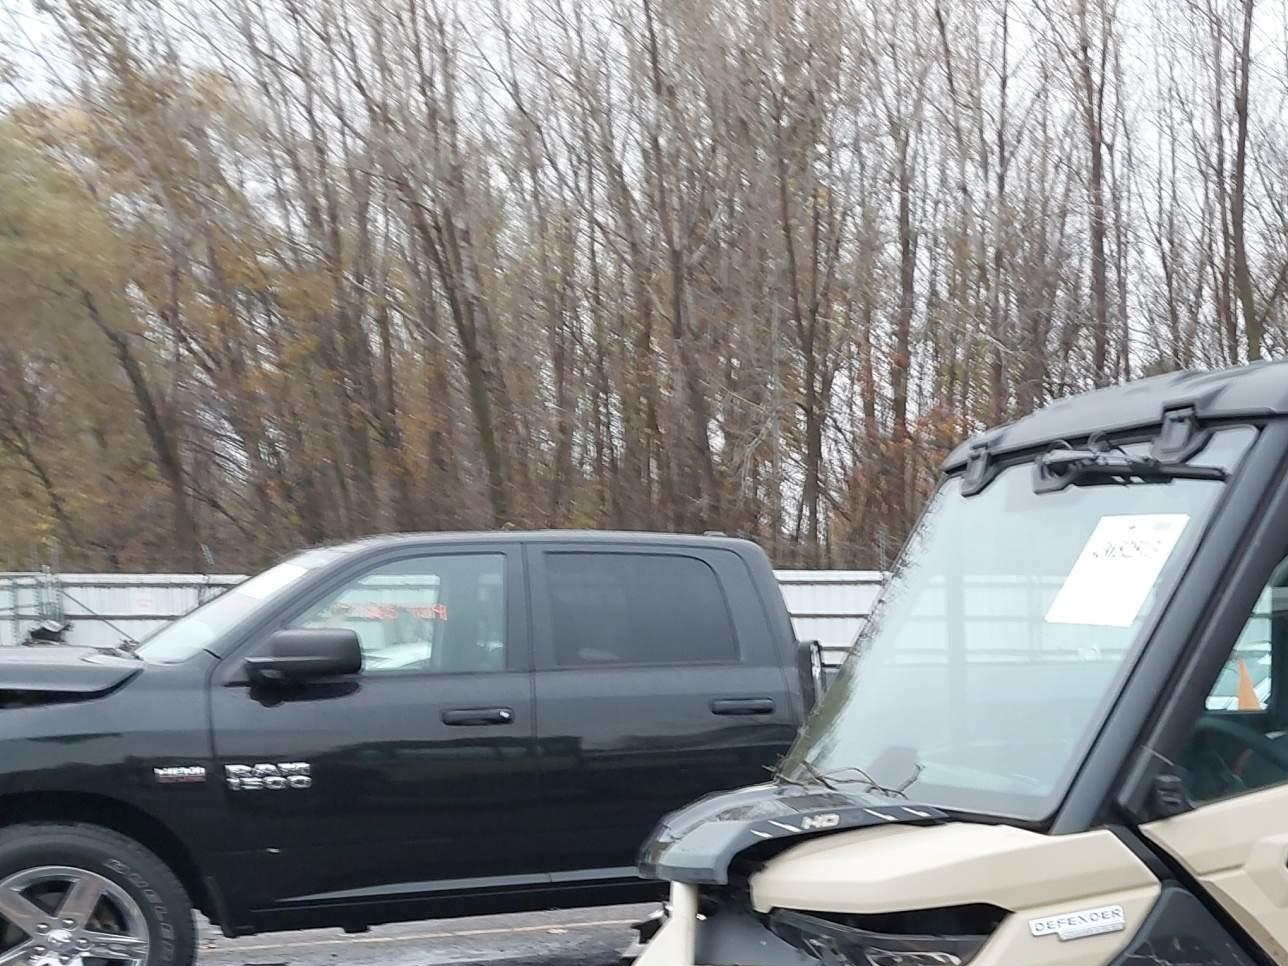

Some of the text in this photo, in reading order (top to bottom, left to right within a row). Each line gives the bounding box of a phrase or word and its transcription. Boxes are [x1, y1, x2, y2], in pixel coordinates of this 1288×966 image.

[226, 775, 313, 791] 1500
[801, 813, 840, 829] HD
[1034, 908, 1121, 932] DEFENDER
